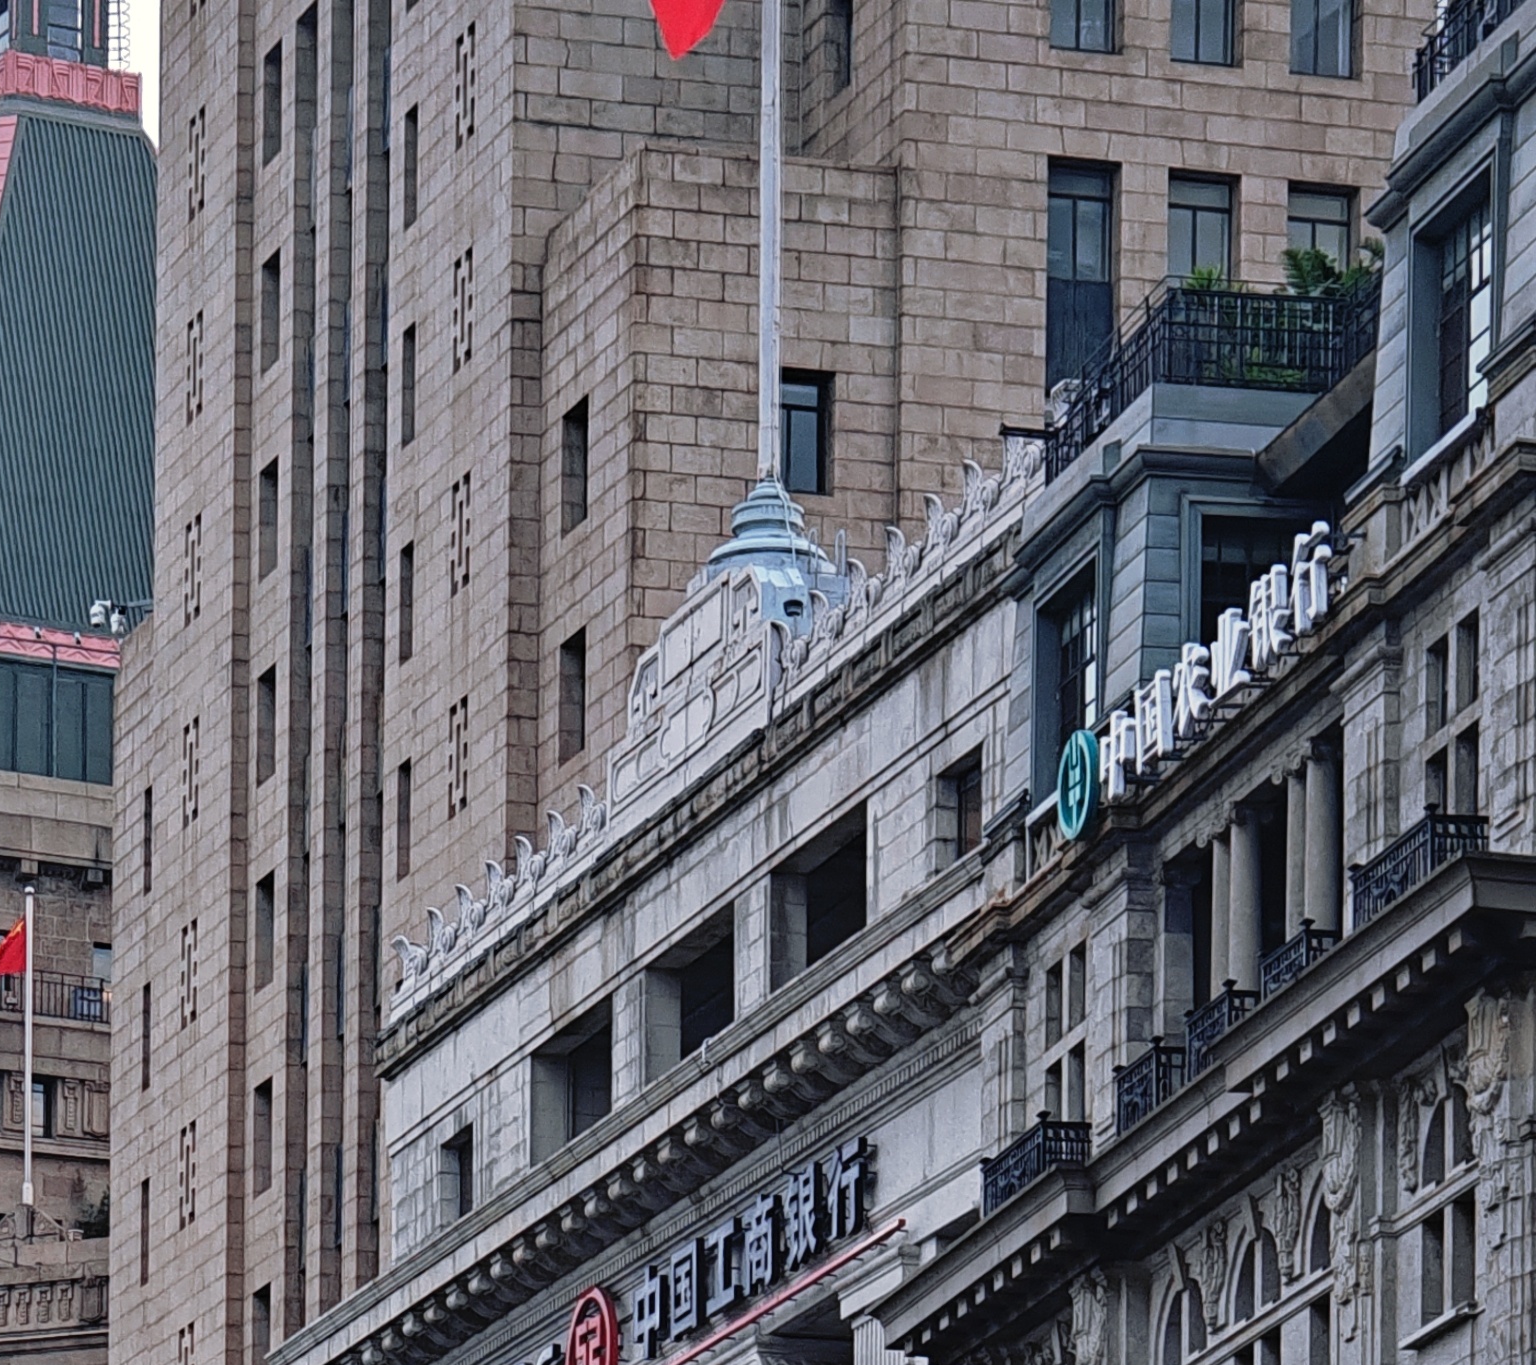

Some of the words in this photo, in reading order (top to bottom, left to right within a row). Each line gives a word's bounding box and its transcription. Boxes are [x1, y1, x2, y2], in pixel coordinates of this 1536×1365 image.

[633, 1136, 869, 1360] 中国工商银行
